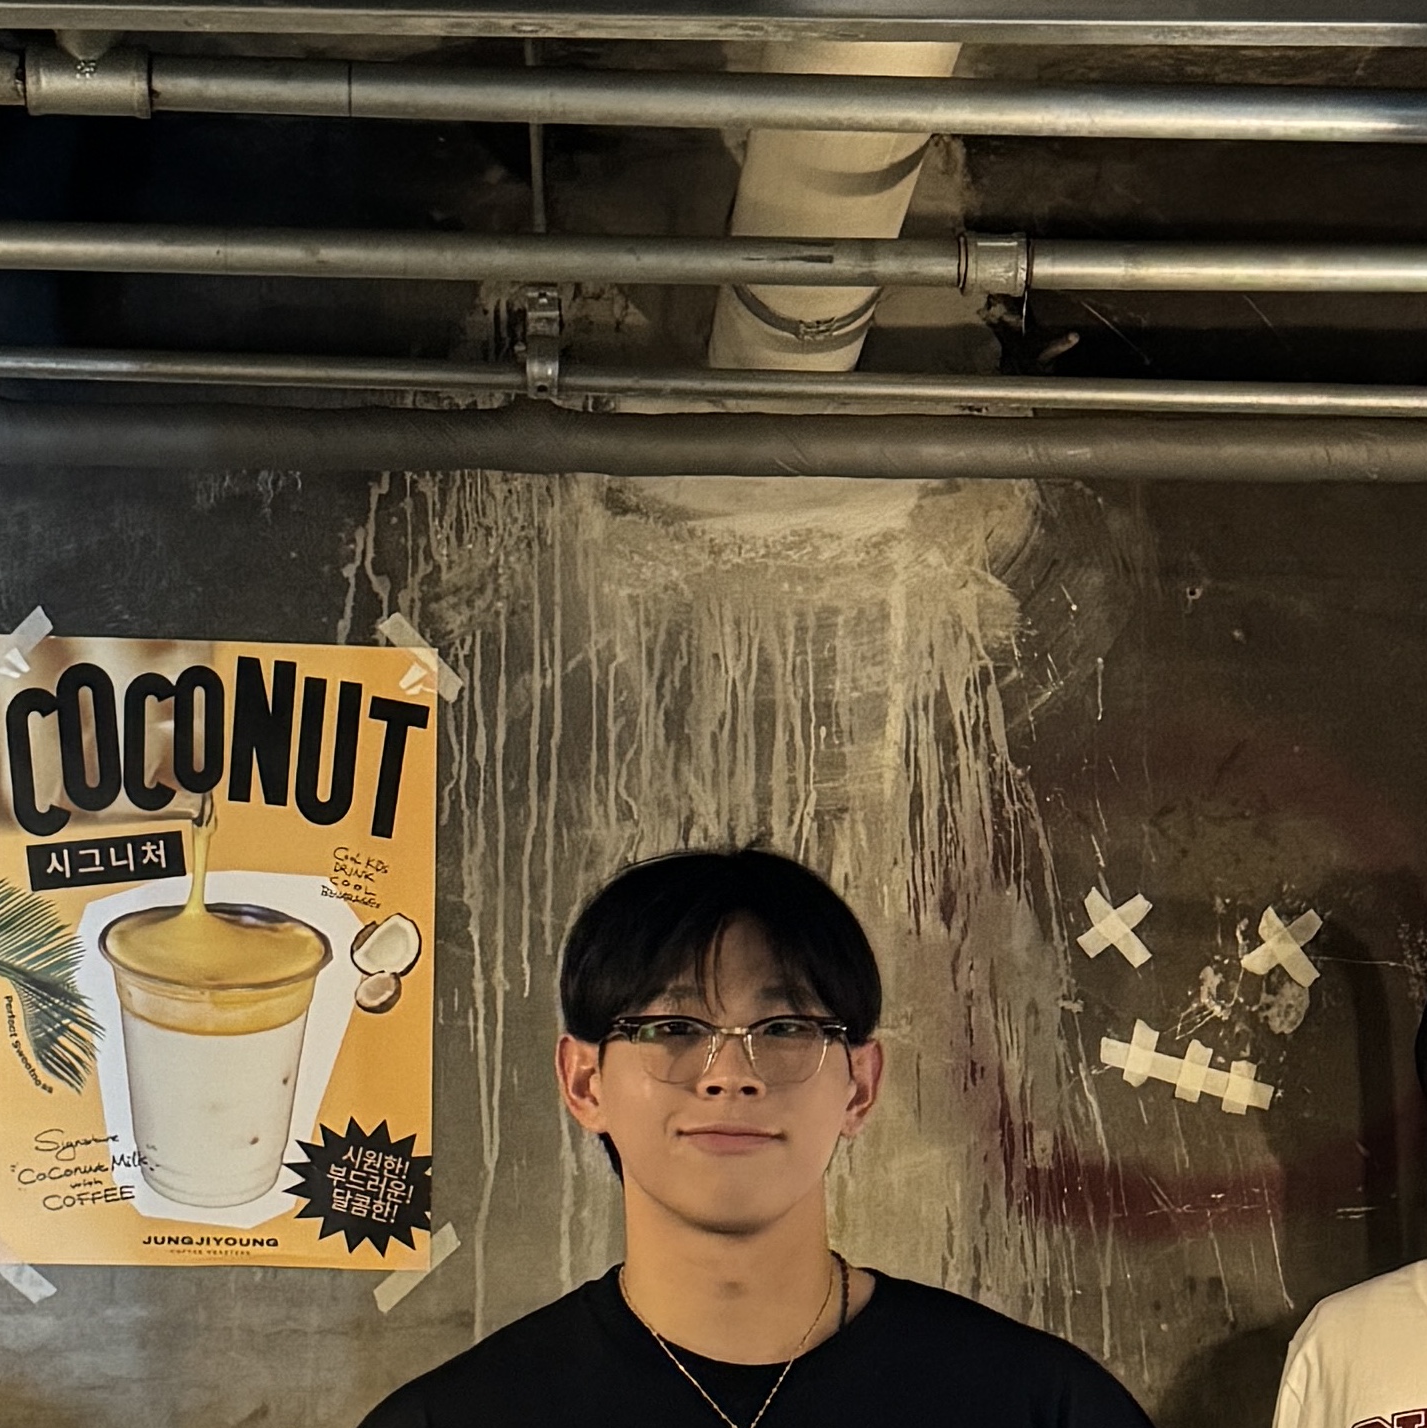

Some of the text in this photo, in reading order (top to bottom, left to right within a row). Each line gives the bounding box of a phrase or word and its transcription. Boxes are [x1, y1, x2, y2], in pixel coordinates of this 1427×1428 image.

[6, 656, 430, 838] COCONUT
[46, 840, 169, 877] 시그니처
[329, 876, 377, 897] COOL
[4, 995, 19, 1039] Perfect
[11, 1039, 54, 1095] Sweetness
[342, 1145, 410, 1180] 시원한!
[42, 1185, 136, 1212] COFFEE
[326, 1163, 415, 1205] 부드러운!
[330, 1189, 400, 1224] 달콤한!
[142, 1236, 280, 1248] JUNGJIYOUNG
